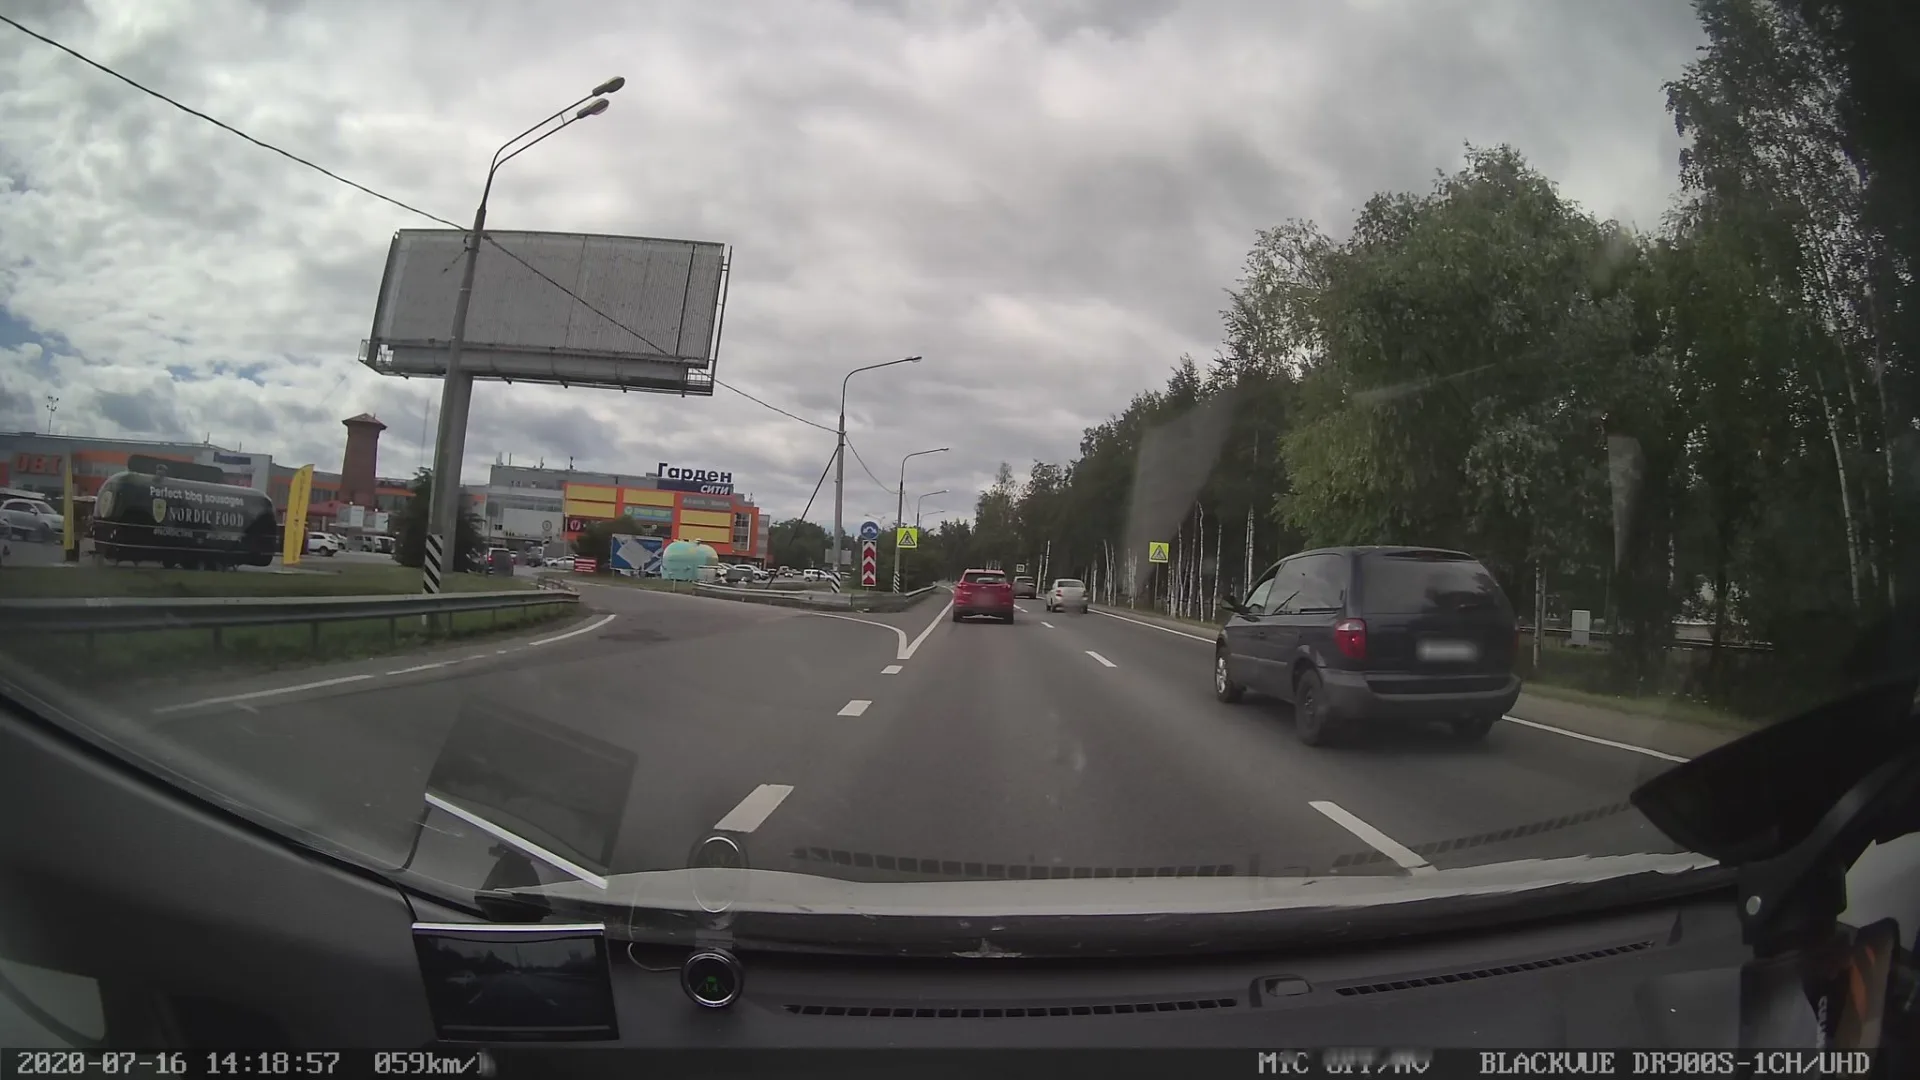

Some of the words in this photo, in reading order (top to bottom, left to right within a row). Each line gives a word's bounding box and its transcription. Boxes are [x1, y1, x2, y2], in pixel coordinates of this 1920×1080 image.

[16, 454, 61, 473] OBI
[657, 462, 732, 483] Гарден
[150, 486, 182, 499] Perfect
[184, 489, 202, 504] bbq
[169, 507, 212, 524] NORDIC
[215, 511, 244, 527] FOOD
